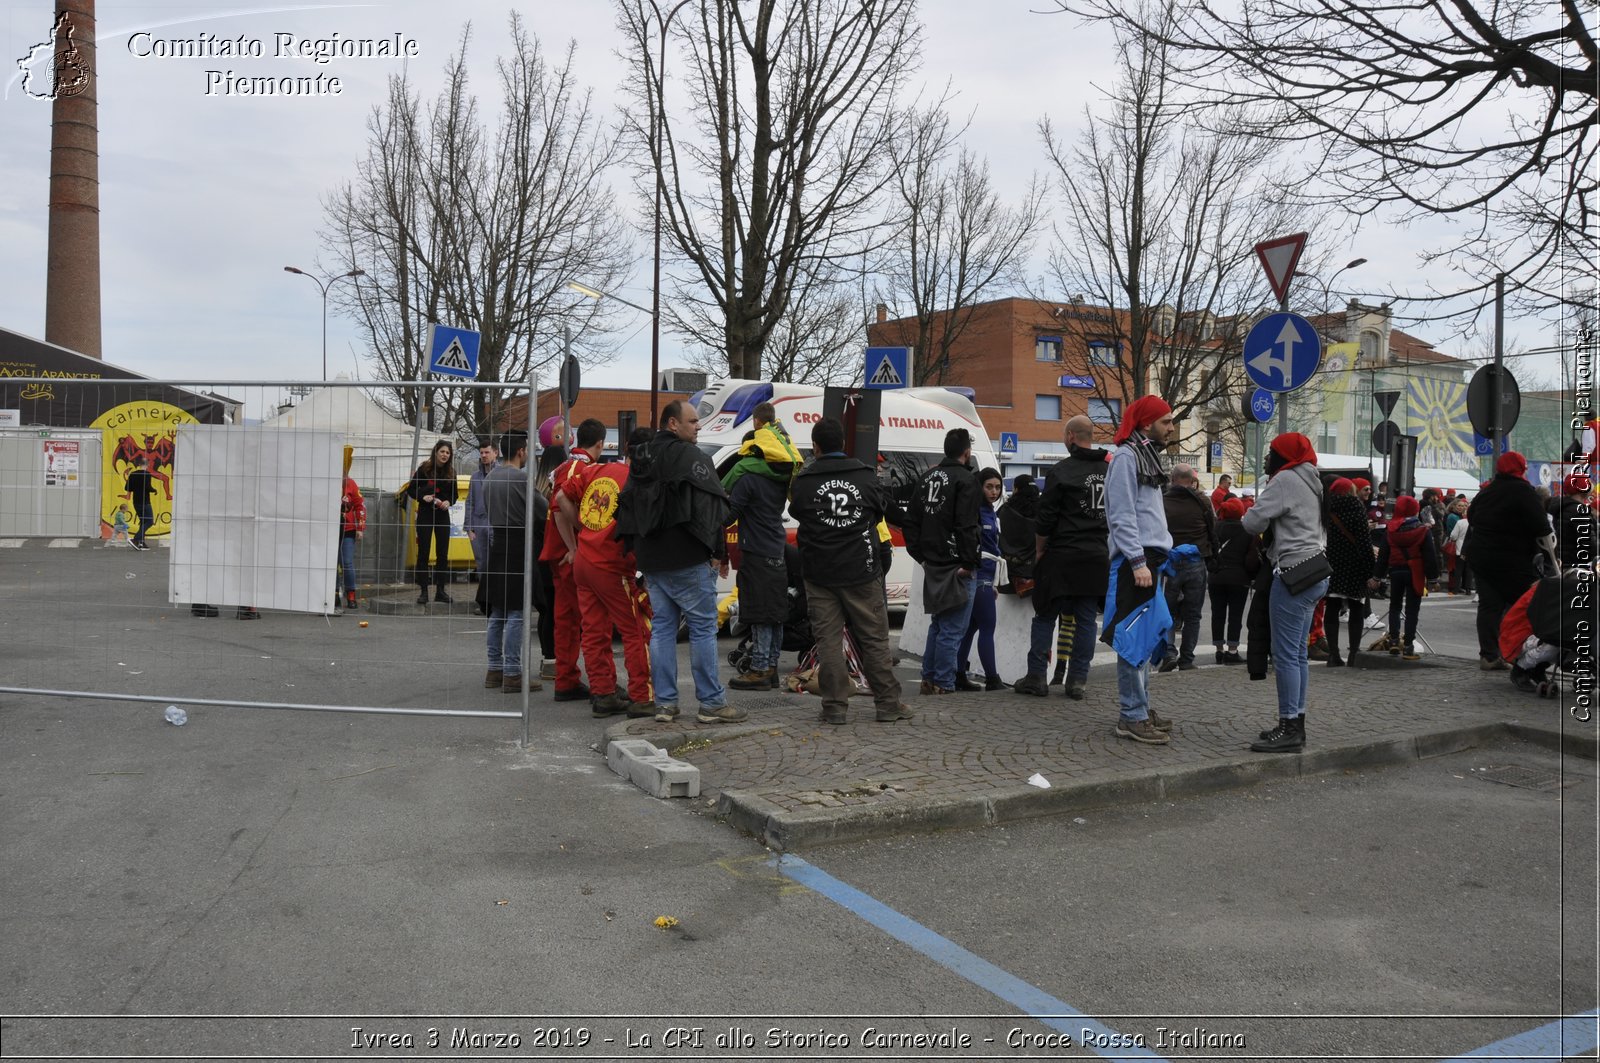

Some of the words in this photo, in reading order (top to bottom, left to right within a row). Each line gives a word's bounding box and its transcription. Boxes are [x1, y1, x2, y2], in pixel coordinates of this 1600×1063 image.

[794, 412, 822, 424] CRO
[888, 416, 945, 430] ITALIANA
[817, 480, 862, 501] DIFENSORI
[927, 480, 941, 503] 12
[1091, 483, 1105, 509] 12
[828, 493, 849, 516] 12
